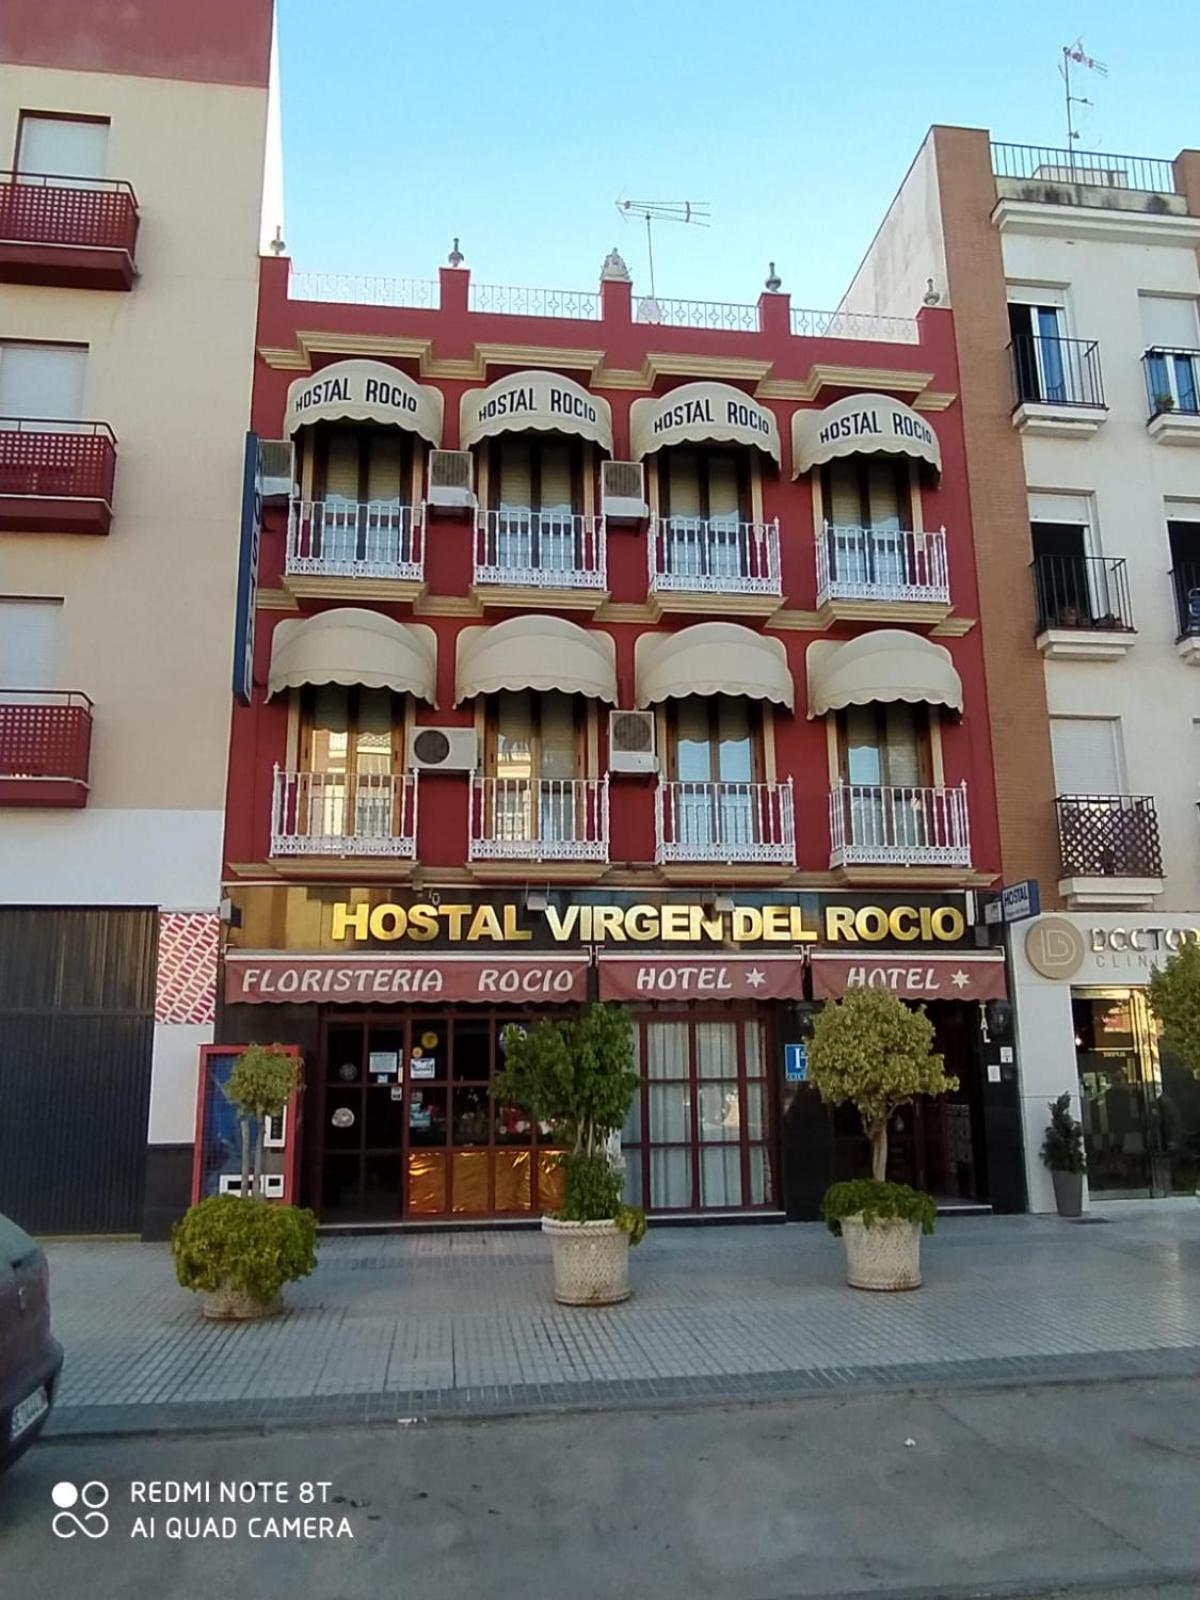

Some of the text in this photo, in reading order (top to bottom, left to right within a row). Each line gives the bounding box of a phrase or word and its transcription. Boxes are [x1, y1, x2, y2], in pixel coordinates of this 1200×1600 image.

[295, 378, 417, 412] HOSTAL ROCIO
[478, 388, 596, 423] HOSTAL ROCIO
[653, 399, 769, 435] HOSTAL ROCIO
[819, 411, 932, 445] HOSTAL ROCIO
[1004, 886, 1028, 907] HOSTAL
[331, 902, 533, 941] HOSTAL
[543, 905, 723, 941] VIRGEN
[731, 906, 818, 941] DEL
[826, 906, 965, 942] ROCIO
[1096, 954, 1160, 969] CLINI
[242, 967, 574, 993] FLORISTERIA ROCIO
[636, 966, 732, 991] HOTEL
[847, 966, 940, 990] HOTEL
